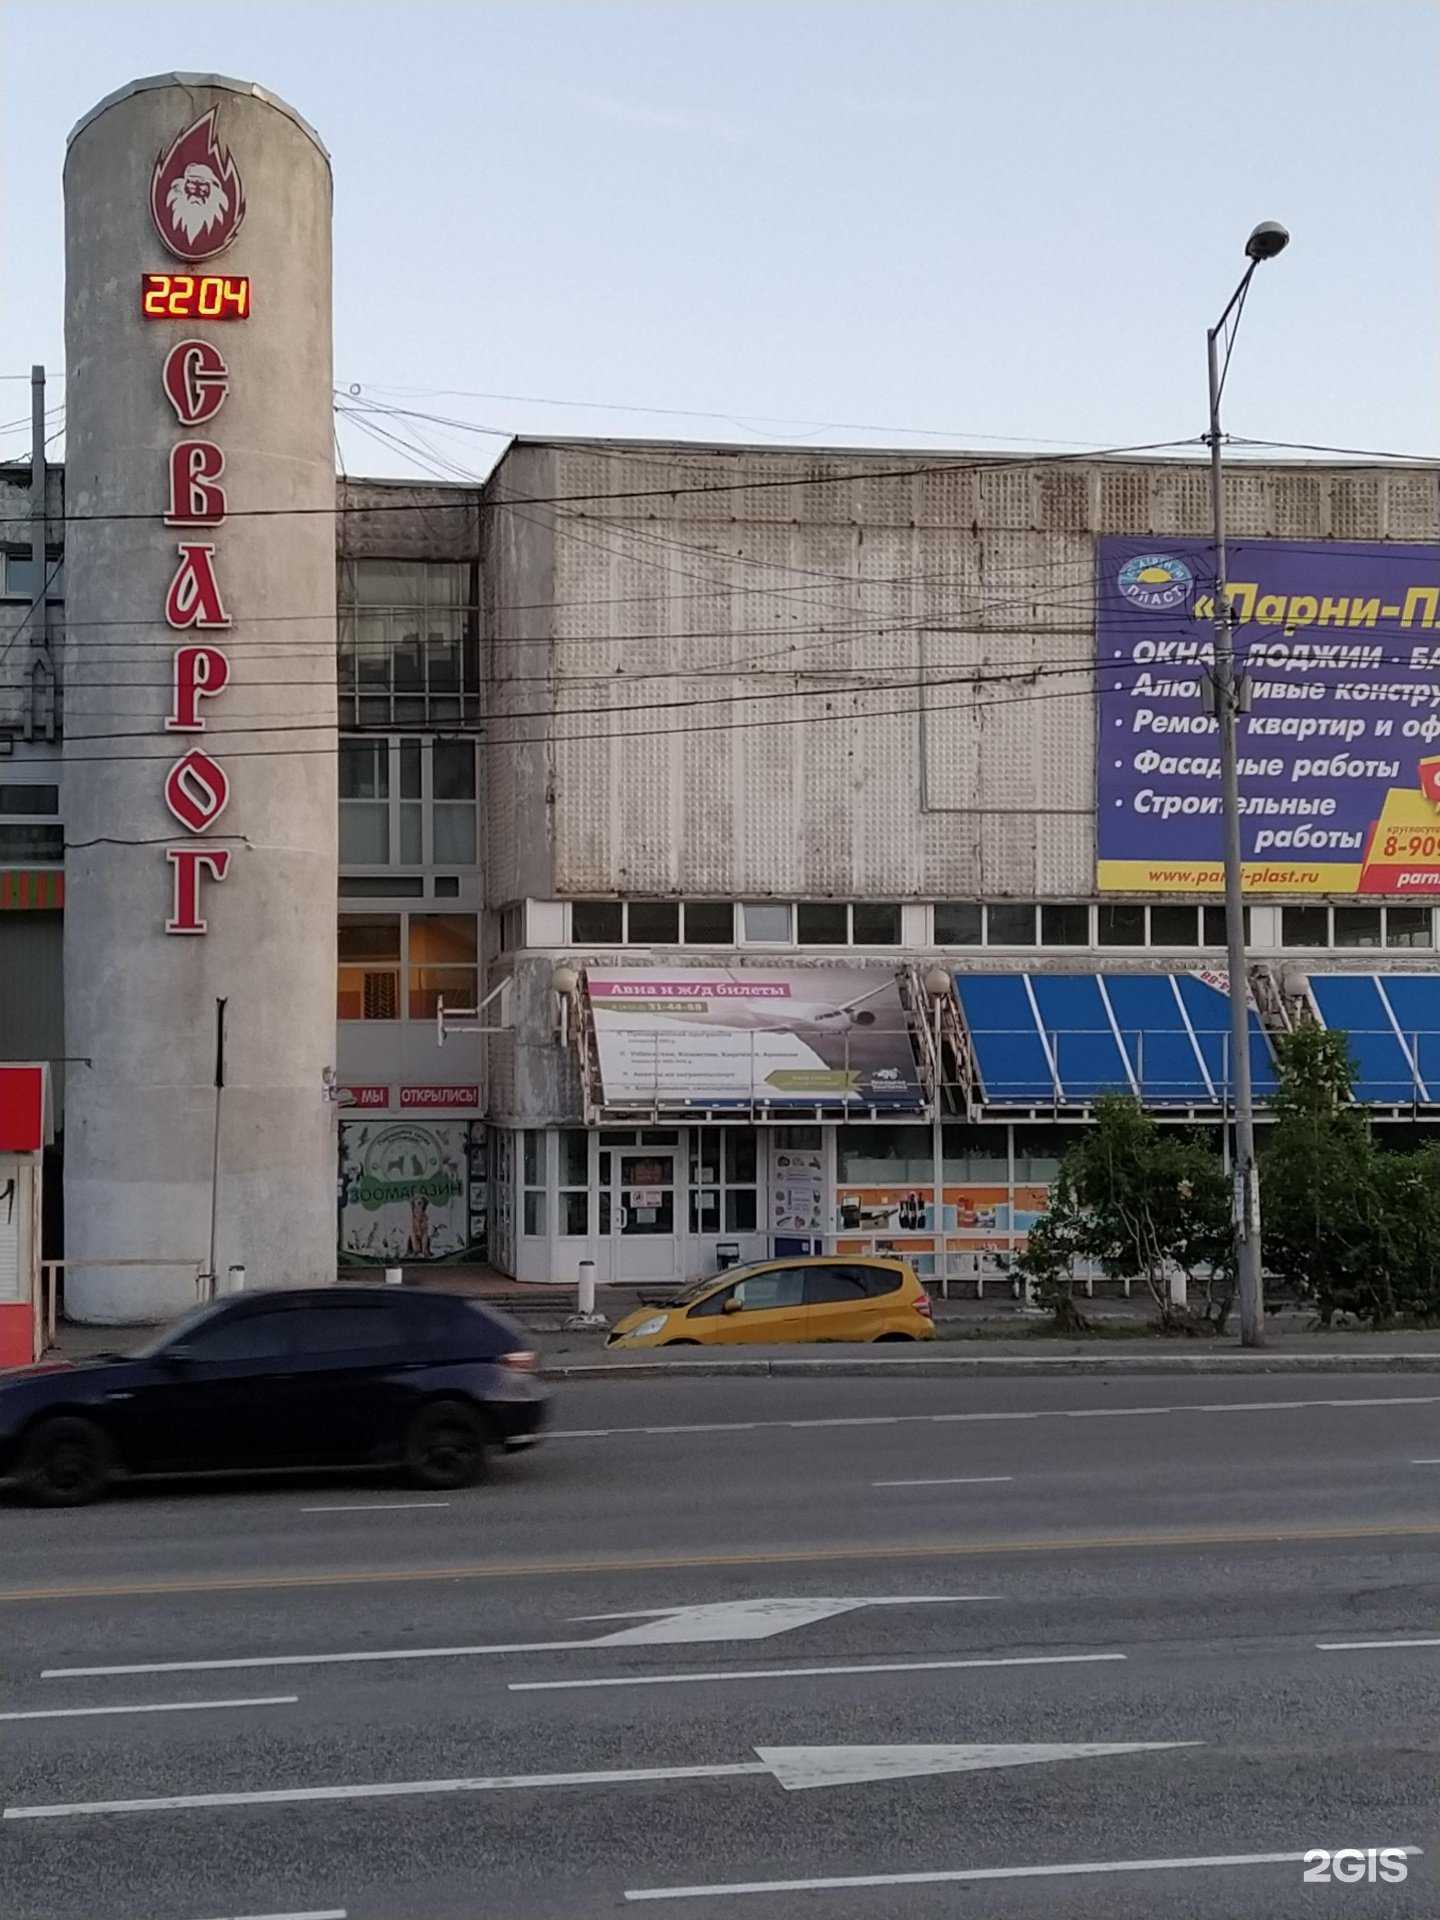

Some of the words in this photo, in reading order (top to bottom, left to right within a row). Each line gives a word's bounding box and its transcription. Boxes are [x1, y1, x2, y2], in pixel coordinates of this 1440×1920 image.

[1127, 584, 1183, 605] ПЛАСТ
[1193, 583, 1440, 637] «Парни-П
[163, 338, 232, 934] СВАРОГ
[1132, 640, 1215, 666] ОКНА
[1243, 643, 1383, 672] ЛОДЖИИ
[1247, 717, 1365, 742] квартир
[1374, 720, 1393, 737] и
[1402, 714, 1440, 743] оф
[1292, 752, 1400, 781] работы
[1254, 824, 1363, 853] работы
[1396, 872, 1440, 888] parn
[611, 983, 656, 996] Авиа
[660, 985, 673, 996] и
[677, 983, 714, 998] ж/д
[716, 983, 785, 997] билеты
[361, 1089, 385, 1104] МЫ
[401, 1088, 478, 1104] ОТКРЫЛИСЬ!
[350, 1180, 463, 1204] ЗООМАГАЗИН
